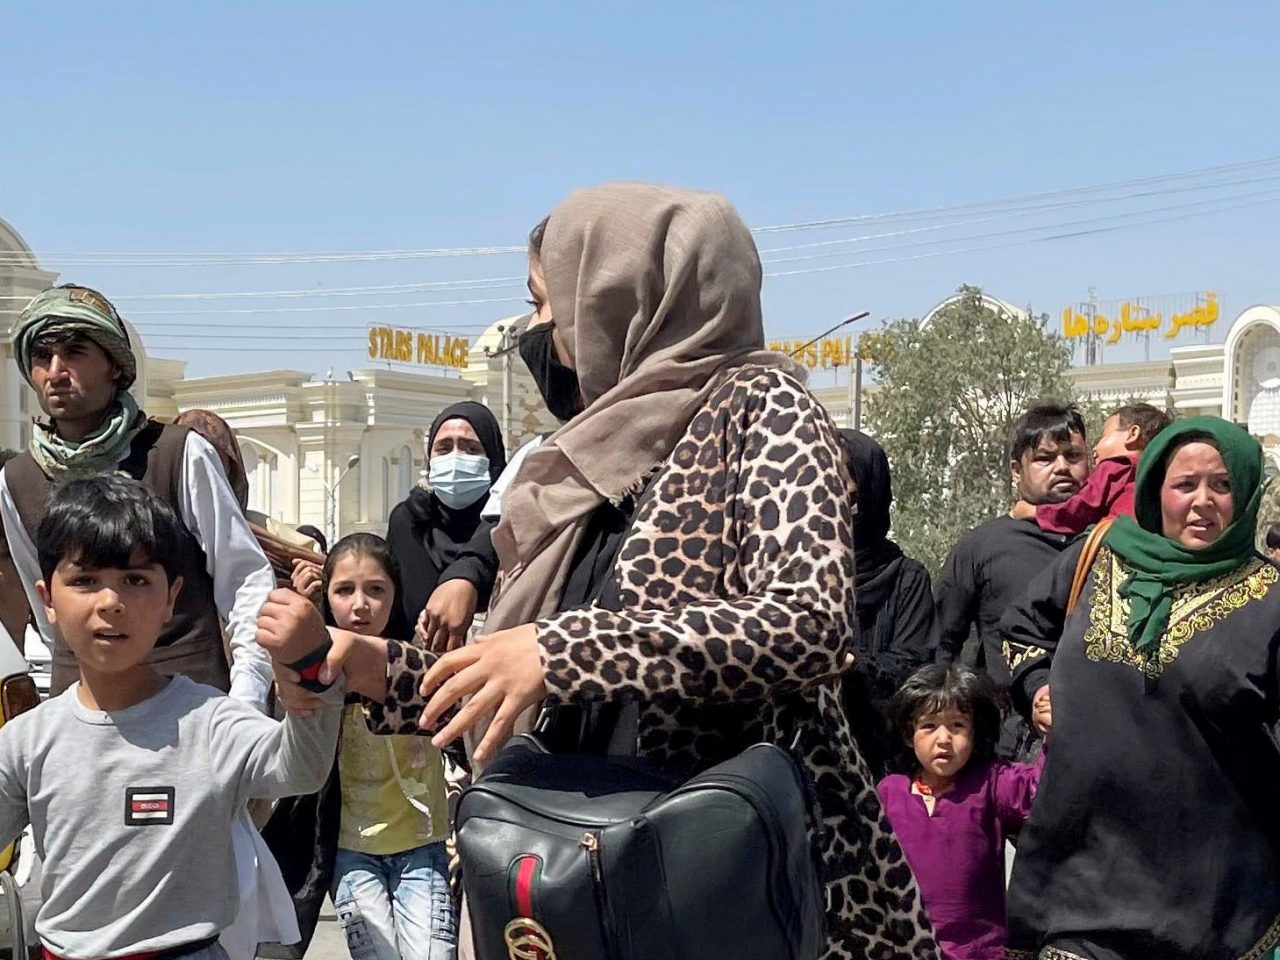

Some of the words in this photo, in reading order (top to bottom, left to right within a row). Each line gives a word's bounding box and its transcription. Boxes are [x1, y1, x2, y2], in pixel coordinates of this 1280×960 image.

[1063, 306, 1089, 337] ها
[1093, 300, 1161, 345] ستاره
[1164, 292, 1218, 338] قصر
[368, 326, 413, 362] STARS
[417, 332, 469, 368] PALACE
